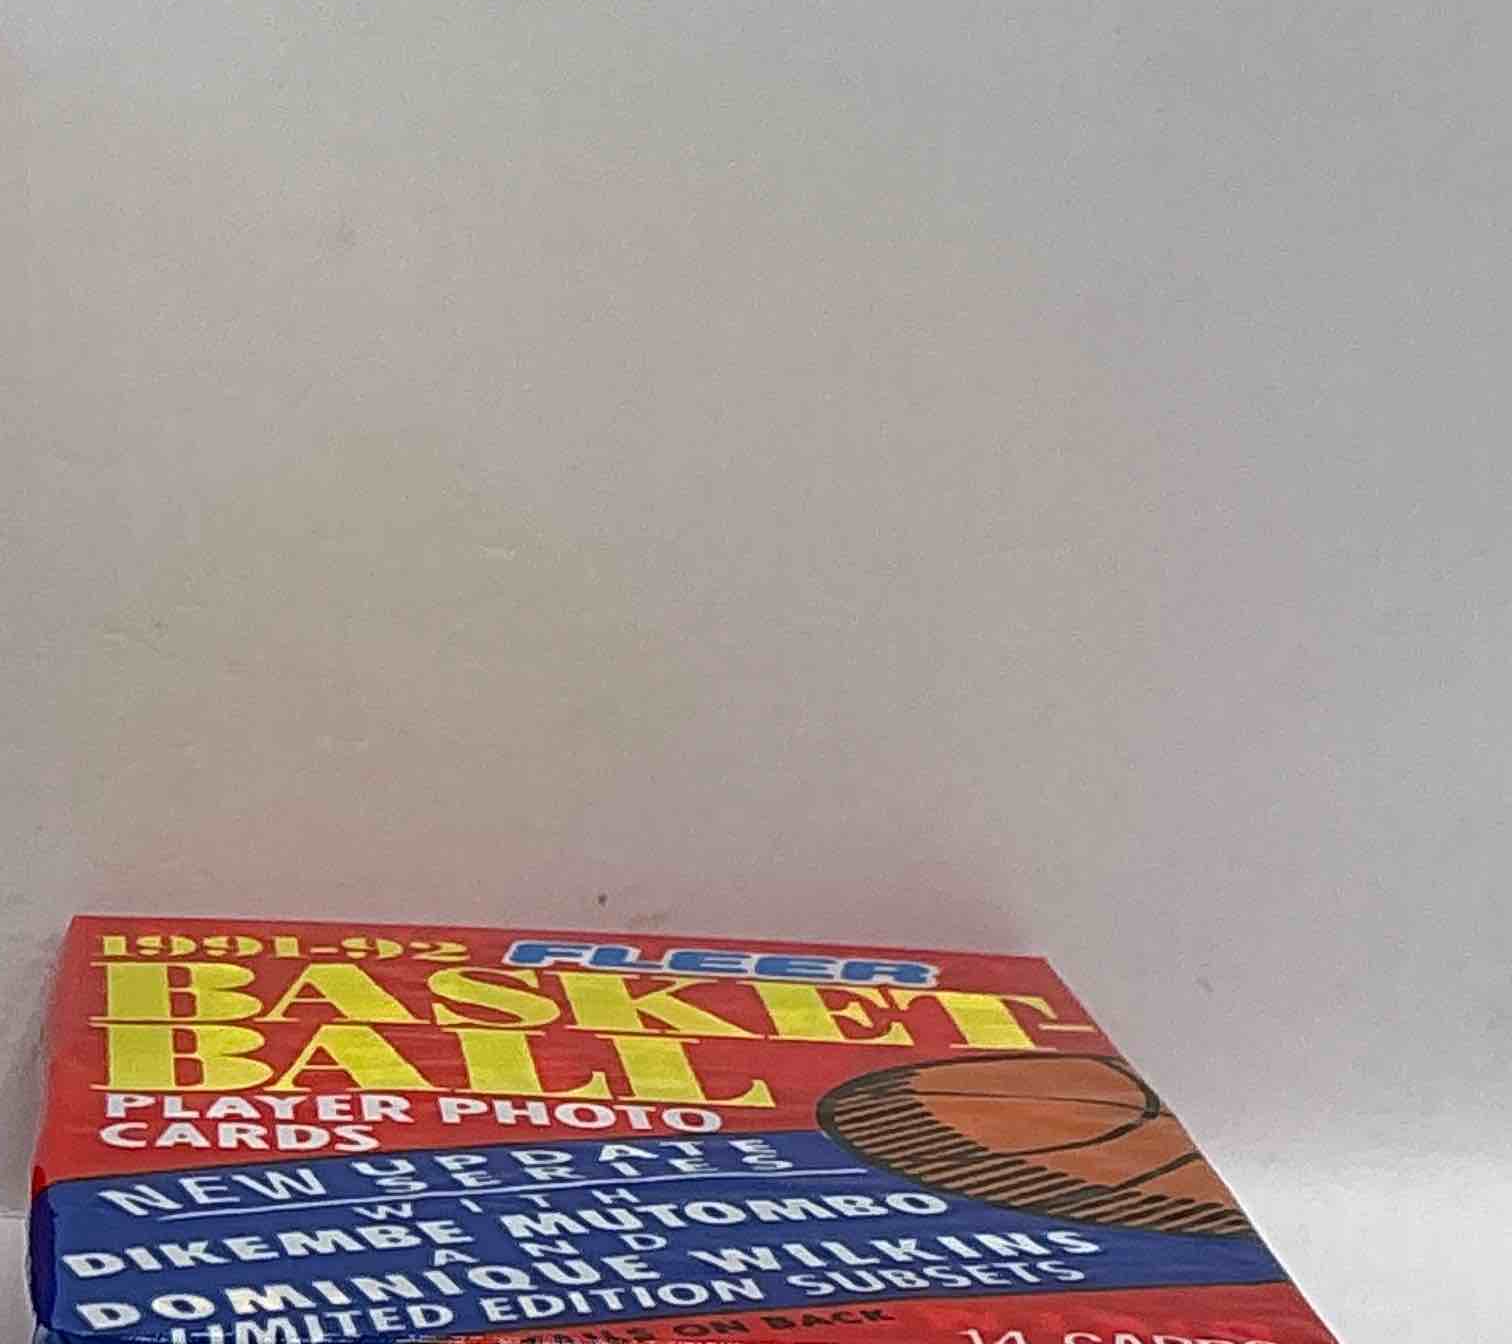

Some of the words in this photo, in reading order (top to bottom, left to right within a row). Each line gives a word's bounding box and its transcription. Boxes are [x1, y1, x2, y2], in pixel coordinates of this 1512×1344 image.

[99, 934, 471, 963] 1991-92
[502, 940, 940, 989] FLEER
[89, 1023, 776, 1109] BALL
[98, 1122, 382, 1152] CARDS
[104, 1093, 418, 1124] PLAYER
[439, 1097, 724, 1134] PHOTO
[98, 1167, 327, 1216] NEW
[352, 1139, 778, 1176] UPDATE
[375, 1153, 794, 1193] SERIES
[352, 1188, 641, 1221] WITH
[61, 1219, 475, 1279] DIKEMBE
[500, 1192, 949, 1241] MUTOMBO
[432, 1233, 669, 1267] AND
[76, 1256, 663, 1331] DOMINIQUE
[691, 1229, 1102, 1274] WILKINS
[480, 1278, 764, 1323] EDITION
[787, 1259, 1088, 1298] SUBSETS
[672, 1319, 752, 1337] ON
[759, 1308, 894, 1331] BACK
